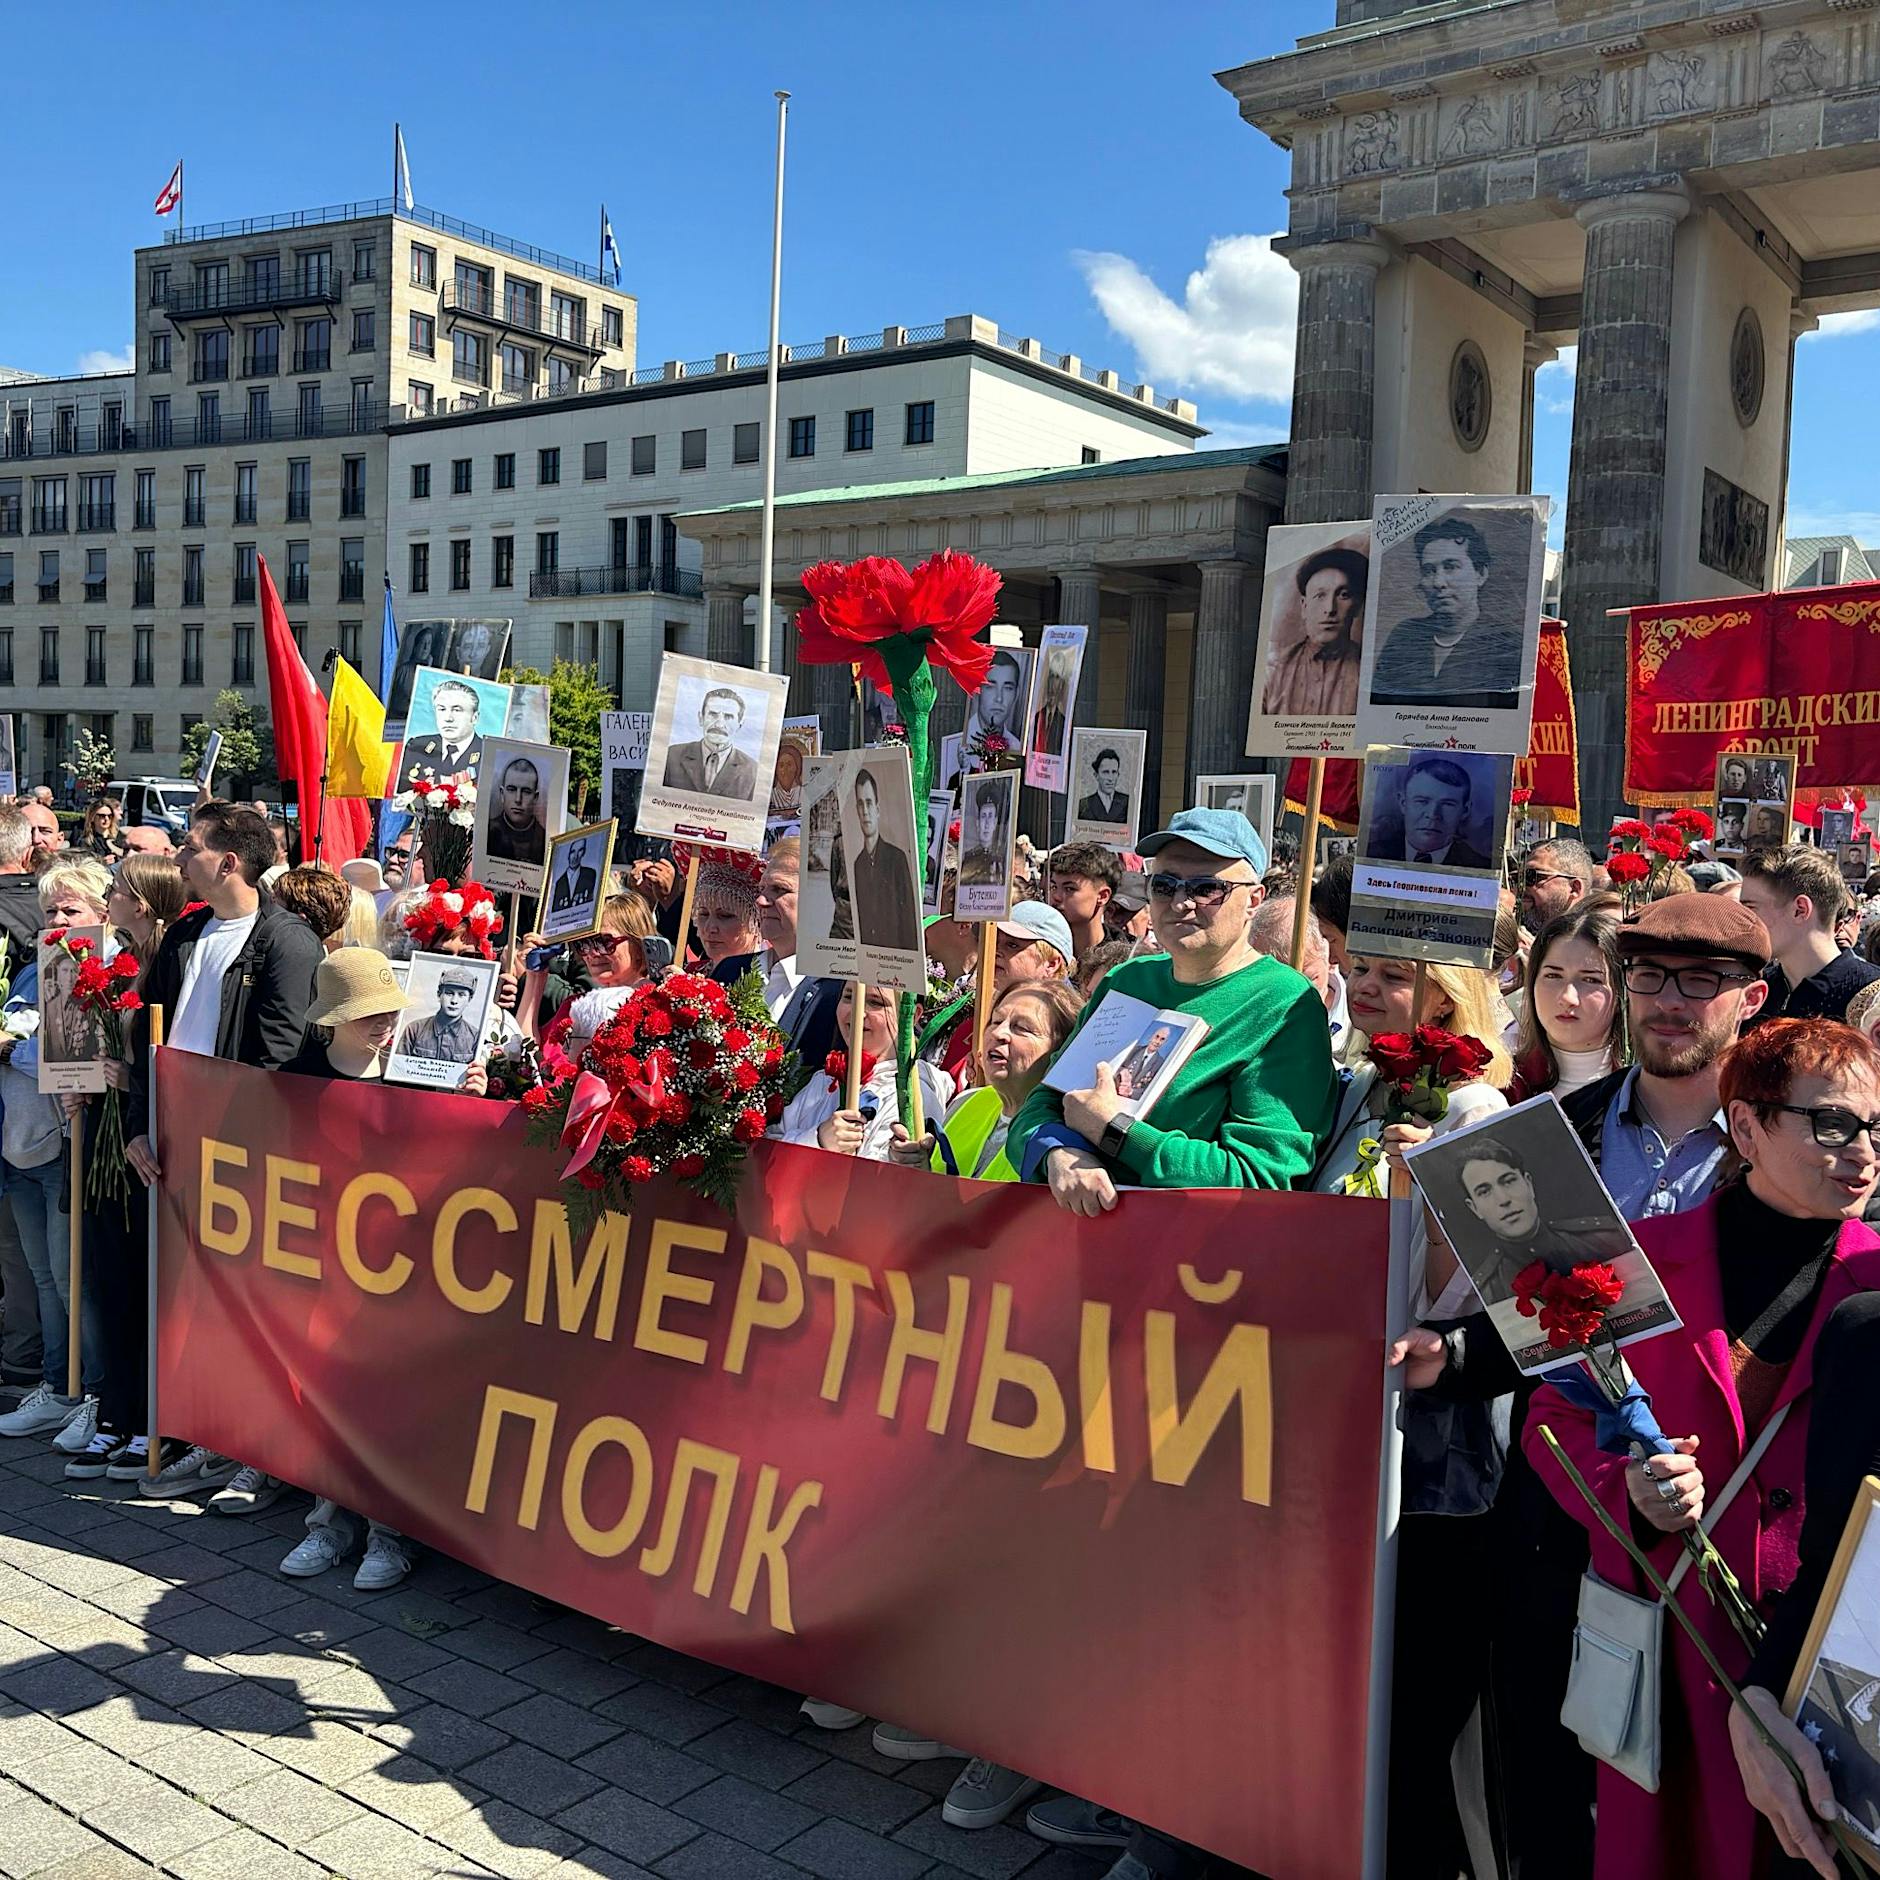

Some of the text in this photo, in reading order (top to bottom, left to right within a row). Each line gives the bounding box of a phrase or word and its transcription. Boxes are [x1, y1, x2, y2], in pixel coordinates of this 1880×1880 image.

[1429, 713, 1450, 722] Анна
[1451, 714, 1490, 724] Ивановна
[1652, 690, 1880, 735] ЛЕНИНГРАДСКИ
[1367, 877, 1392, 888] Здесь
[1393, 881, 1448, 894] Георгиевская
[1384, 908, 1459, 926] Дмитриев
[1351, 921, 1413, 938] Василий
[201, 1137, 1273, 1507] БЕССМЕРТНЫЙ
[465, 1384, 824, 1635] ПОЛК
